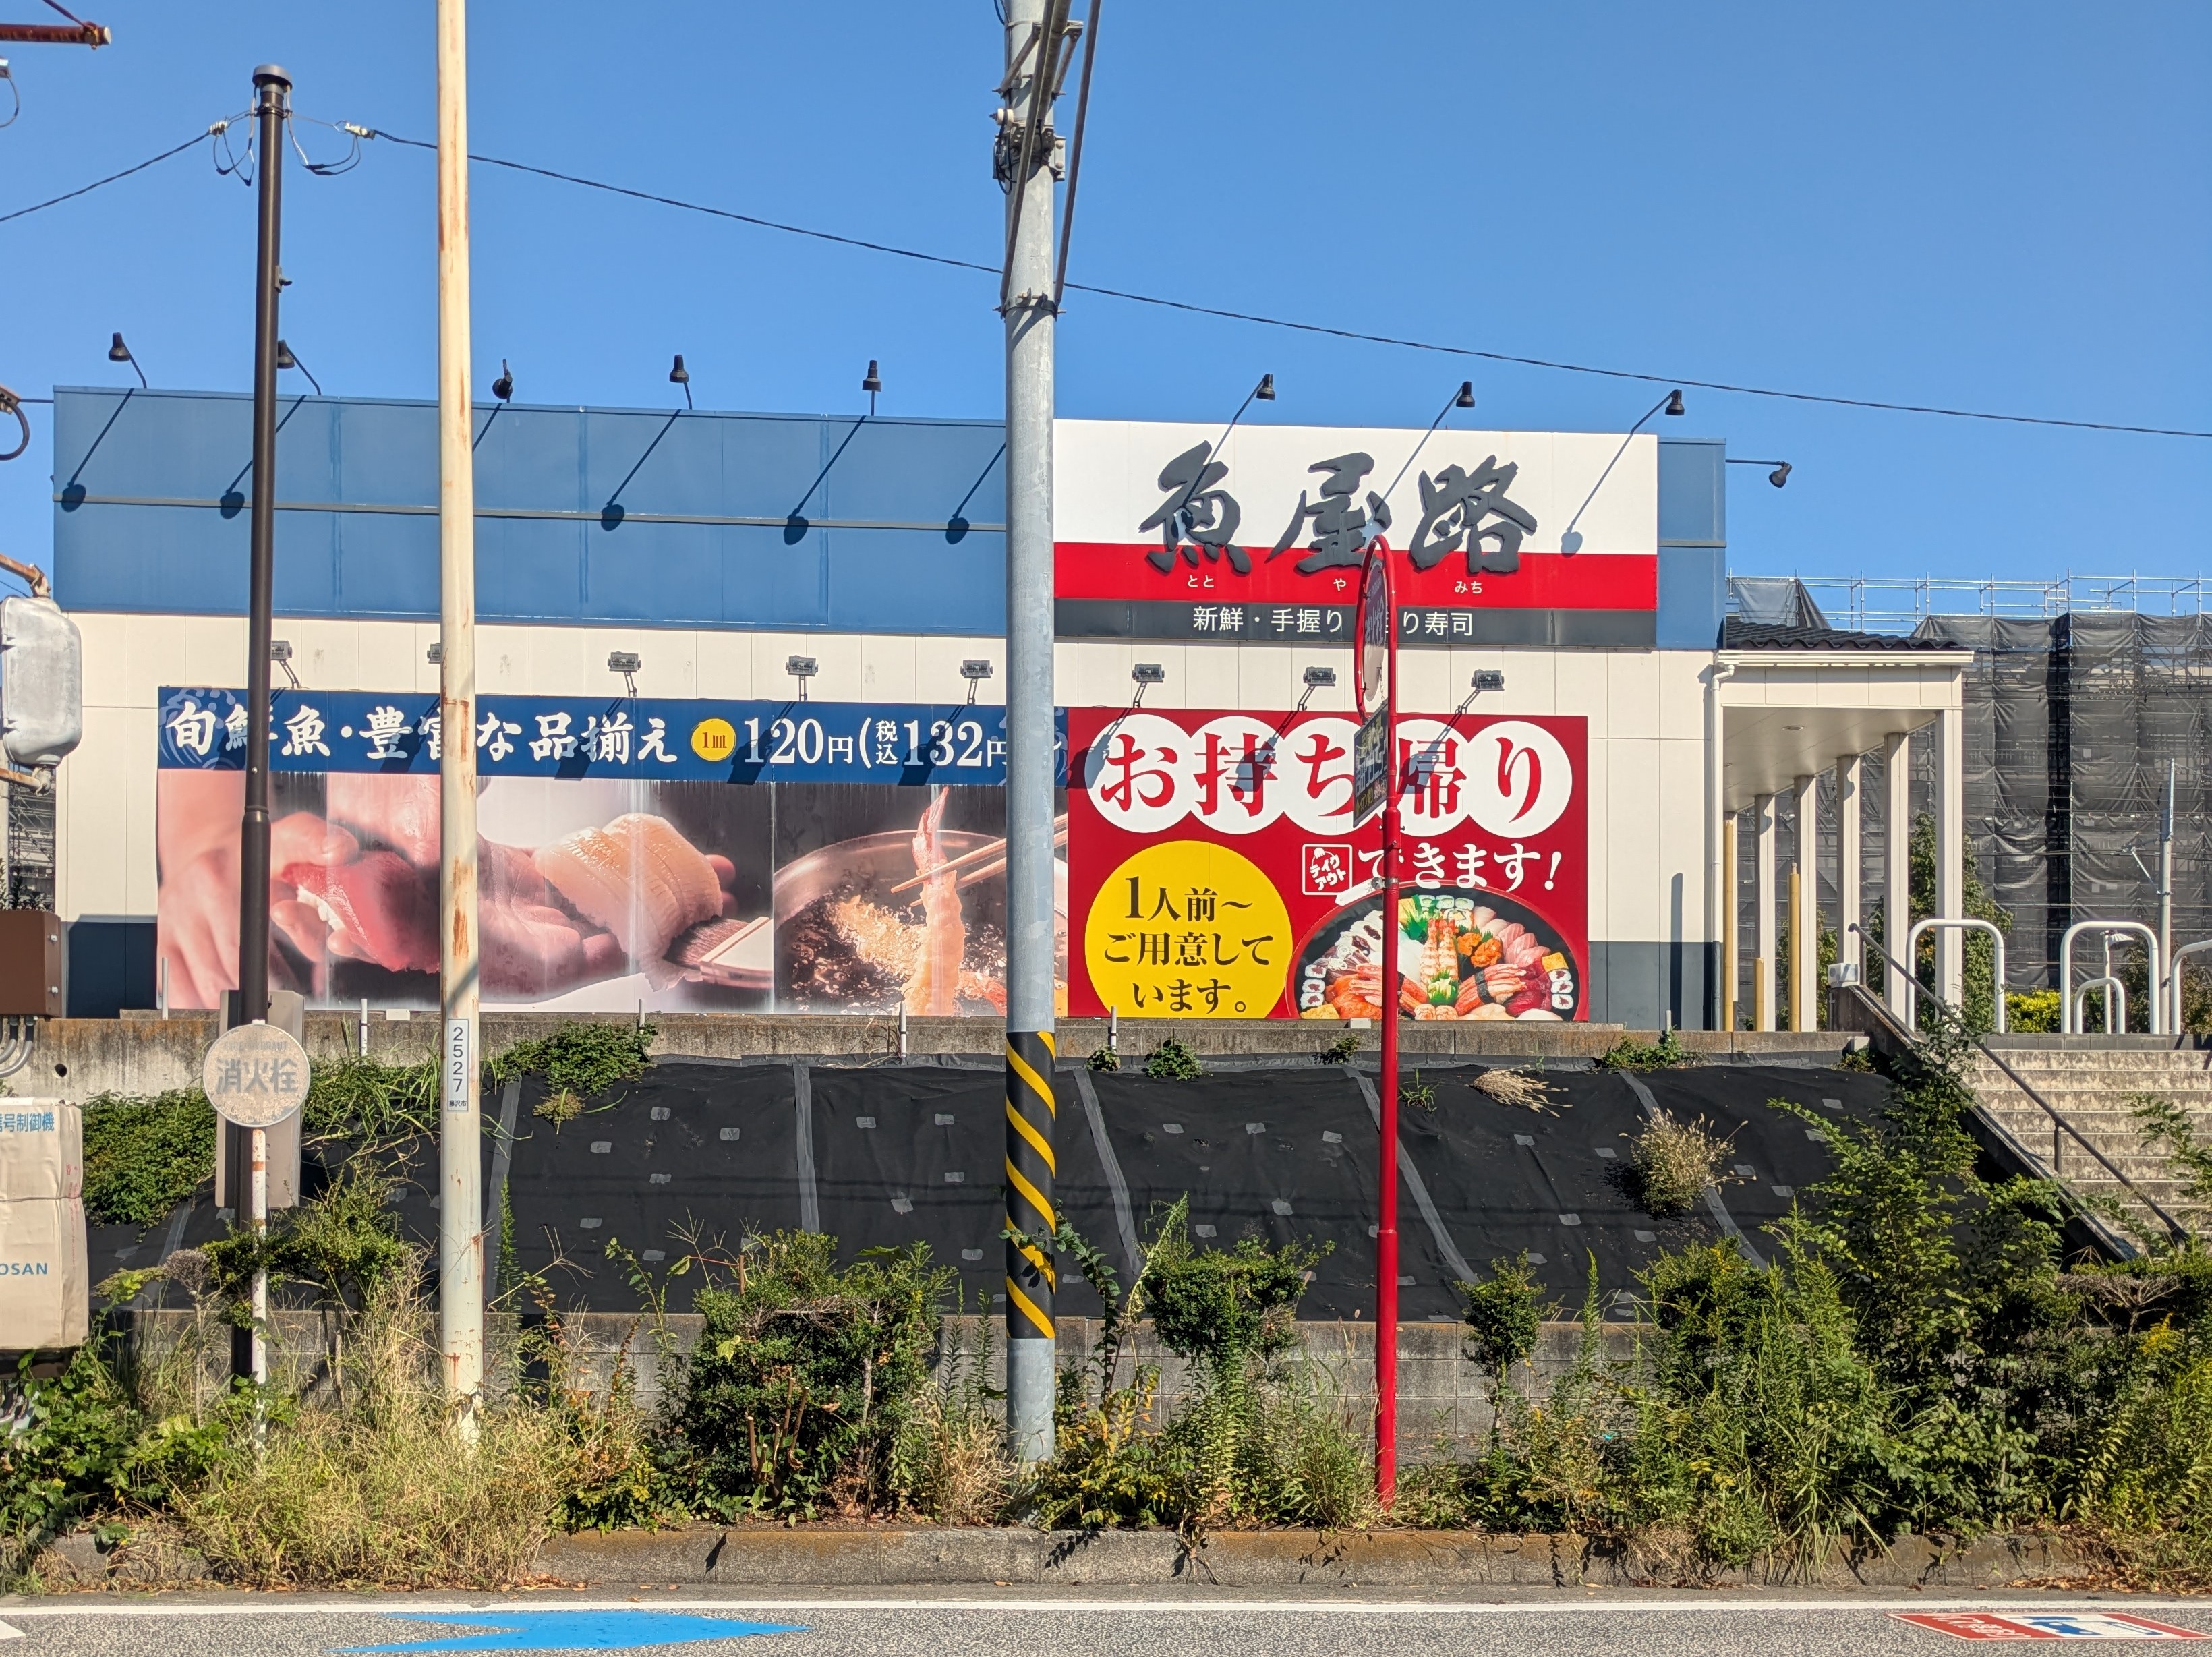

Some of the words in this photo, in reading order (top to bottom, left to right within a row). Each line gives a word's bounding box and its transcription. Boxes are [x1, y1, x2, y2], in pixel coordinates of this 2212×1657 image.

[1139, 439, 1536, 574] 魚屋路
[1188, 575, 1215, 588] とと
[1333, 578, 1347, 591] や
[1455, 581, 1482, 594] みち
[701, 730, 727, 749] 1皿
[1101, 732, 1542, 823] お持ち帰り
[1315, 868, 1347, 891] アウト
[1103, 930, 1275, 967] ご用意して
[1133, 978, 1246, 1014] います。
[216, 1057, 297, 1095] 消火栓
[453, 1026, 463, 1093] 2527
[0, 1111, 55, 1133] 号制御機
